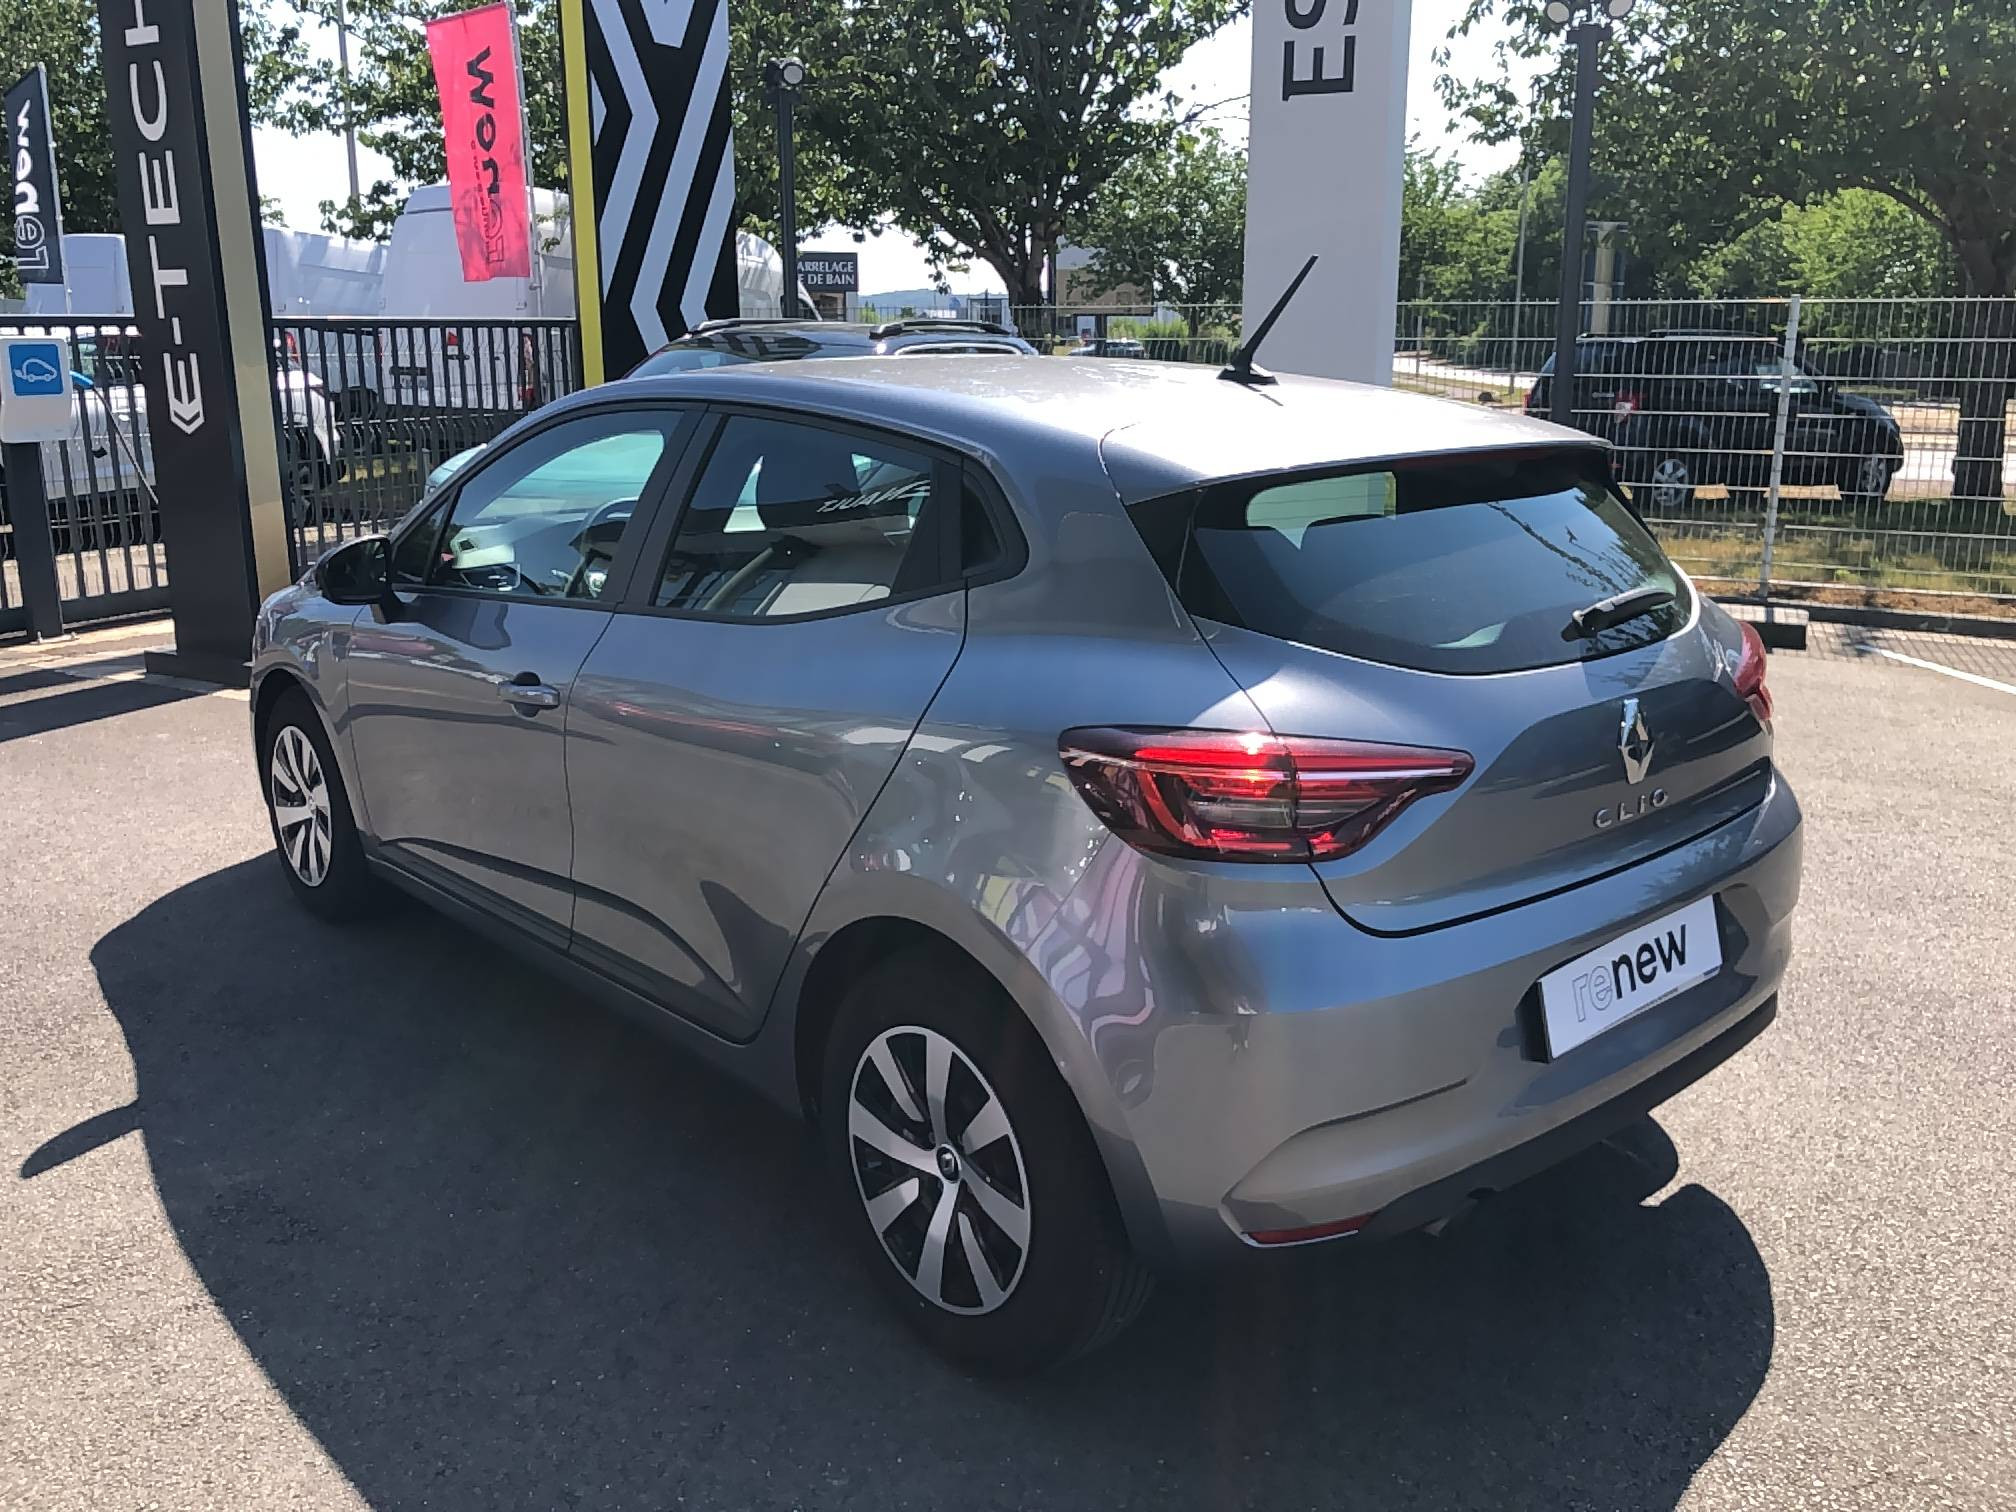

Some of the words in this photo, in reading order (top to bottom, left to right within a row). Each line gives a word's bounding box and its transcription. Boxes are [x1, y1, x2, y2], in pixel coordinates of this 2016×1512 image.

[807, 273, 824, 285] DE
[825, 273, 855, 285] BAIN
[1571, 923, 1687, 1023] renew
